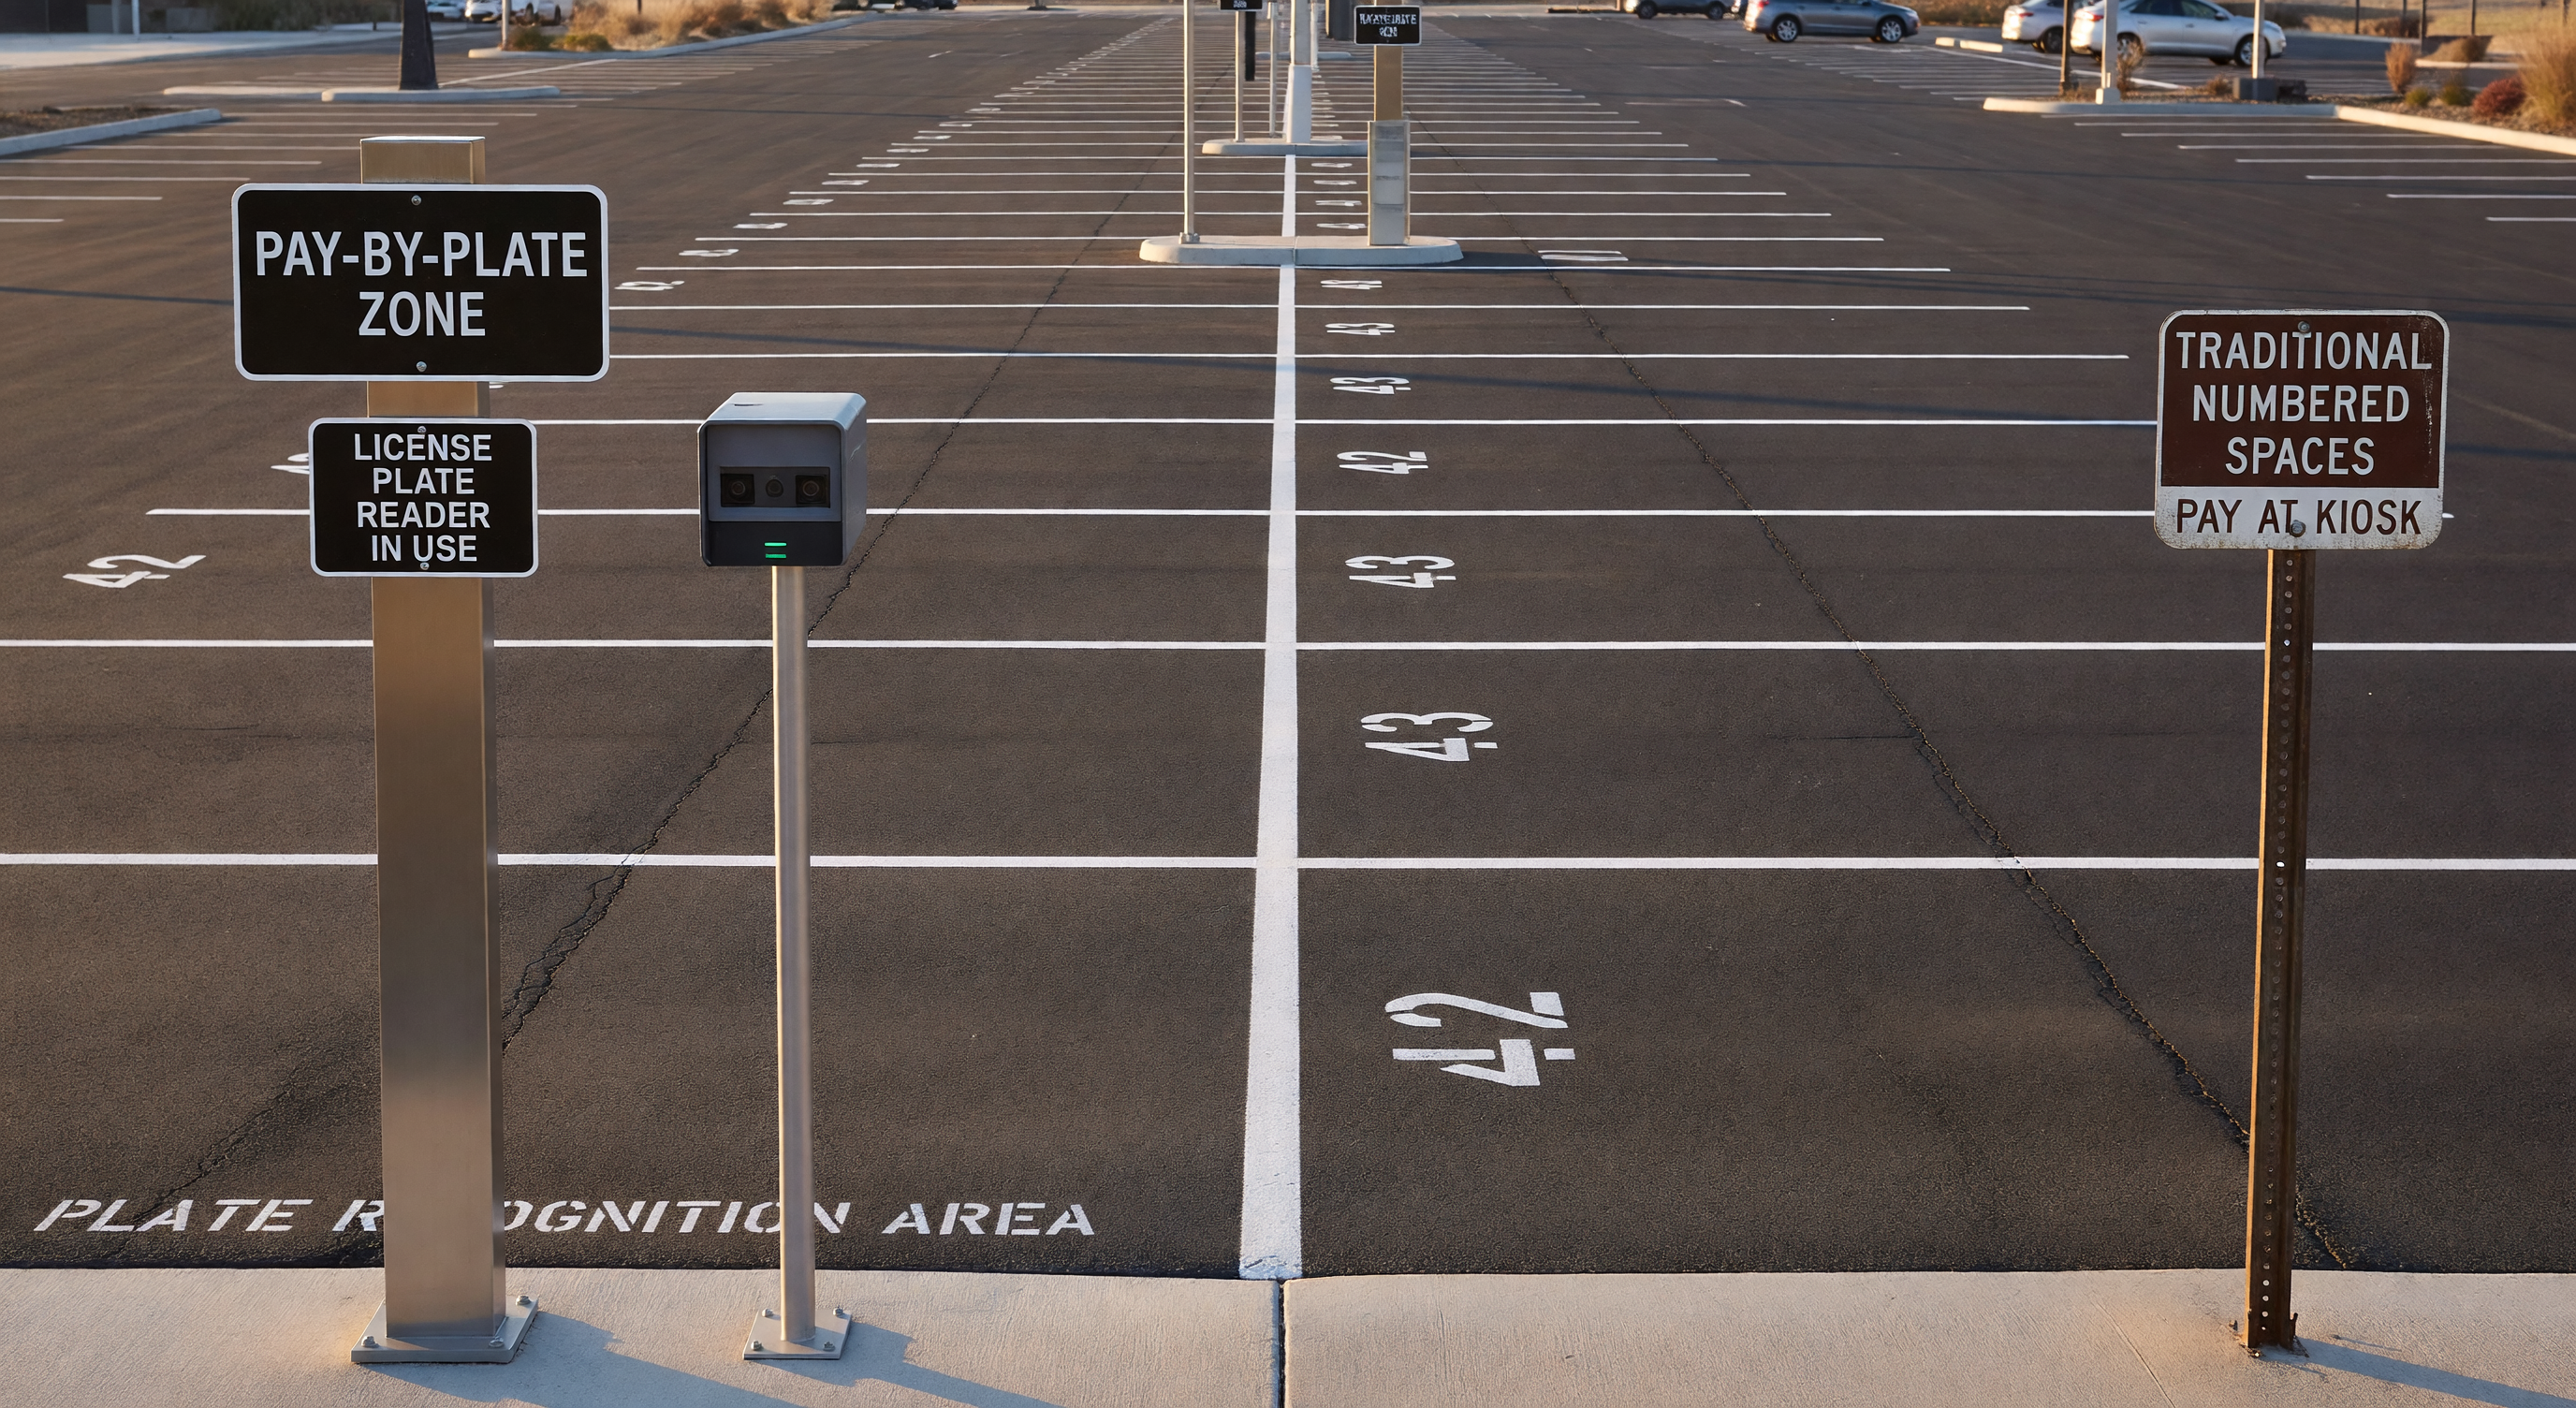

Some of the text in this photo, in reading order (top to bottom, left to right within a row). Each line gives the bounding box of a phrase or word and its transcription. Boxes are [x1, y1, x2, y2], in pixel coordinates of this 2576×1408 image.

[256, 230, 588, 277] PAY-BY-PLATE
[359, 291, 486, 337] ZONE
[2175, 331, 2433, 370] TRADITIONAL
[1329, 376, 1412, 395] 43
[2193, 385, 2410, 422] NUMBERED
[354, 433, 492, 462] LICENSE
[1337, 450, 1429, 475] 42
[2225, 437, 2375, 476] SPACES
[373, 467, 475, 495] PLATE
[357, 501, 490, 529] READER
[2176, 498, 2422, 535] PAY AT KIOSK
[372, 535, 477, 562] IN USE
[62, 554, 207, 589] 42
[1344, 555, 1456, 589] 43
[1360, 711, 1499, 762] 43
[1384, 991, 1576, 1087] 42
[33, 1198, 1095, 1236] PLATE ROGNITION AREA
